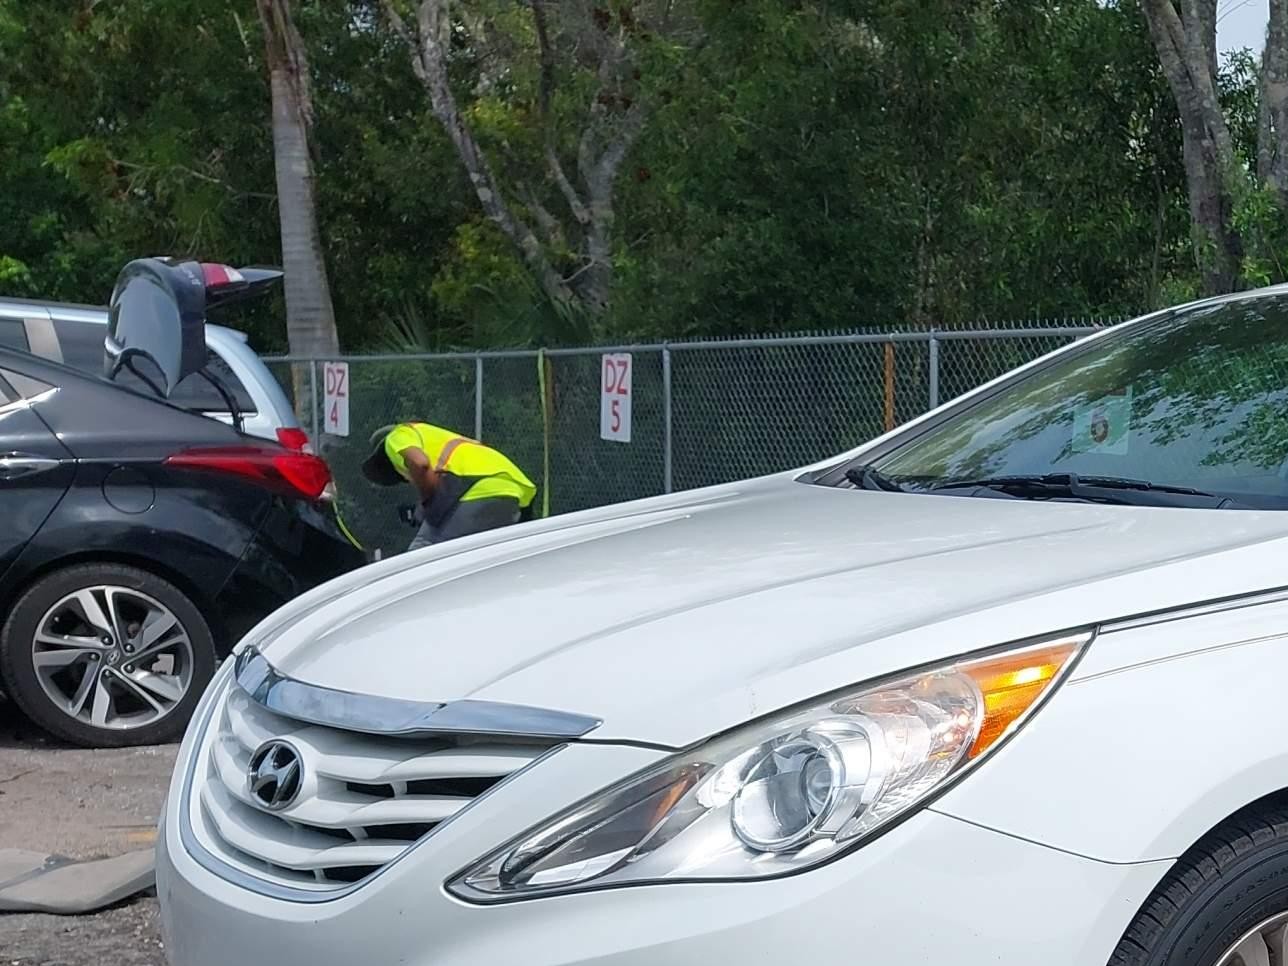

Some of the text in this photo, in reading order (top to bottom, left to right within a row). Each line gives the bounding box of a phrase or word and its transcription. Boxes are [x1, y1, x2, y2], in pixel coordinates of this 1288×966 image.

[326, 368, 346, 397] DZ
[604, 359, 629, 395] DZ
[329, 402, 339, 428] 4
[611, 400, 621, 433] 5
